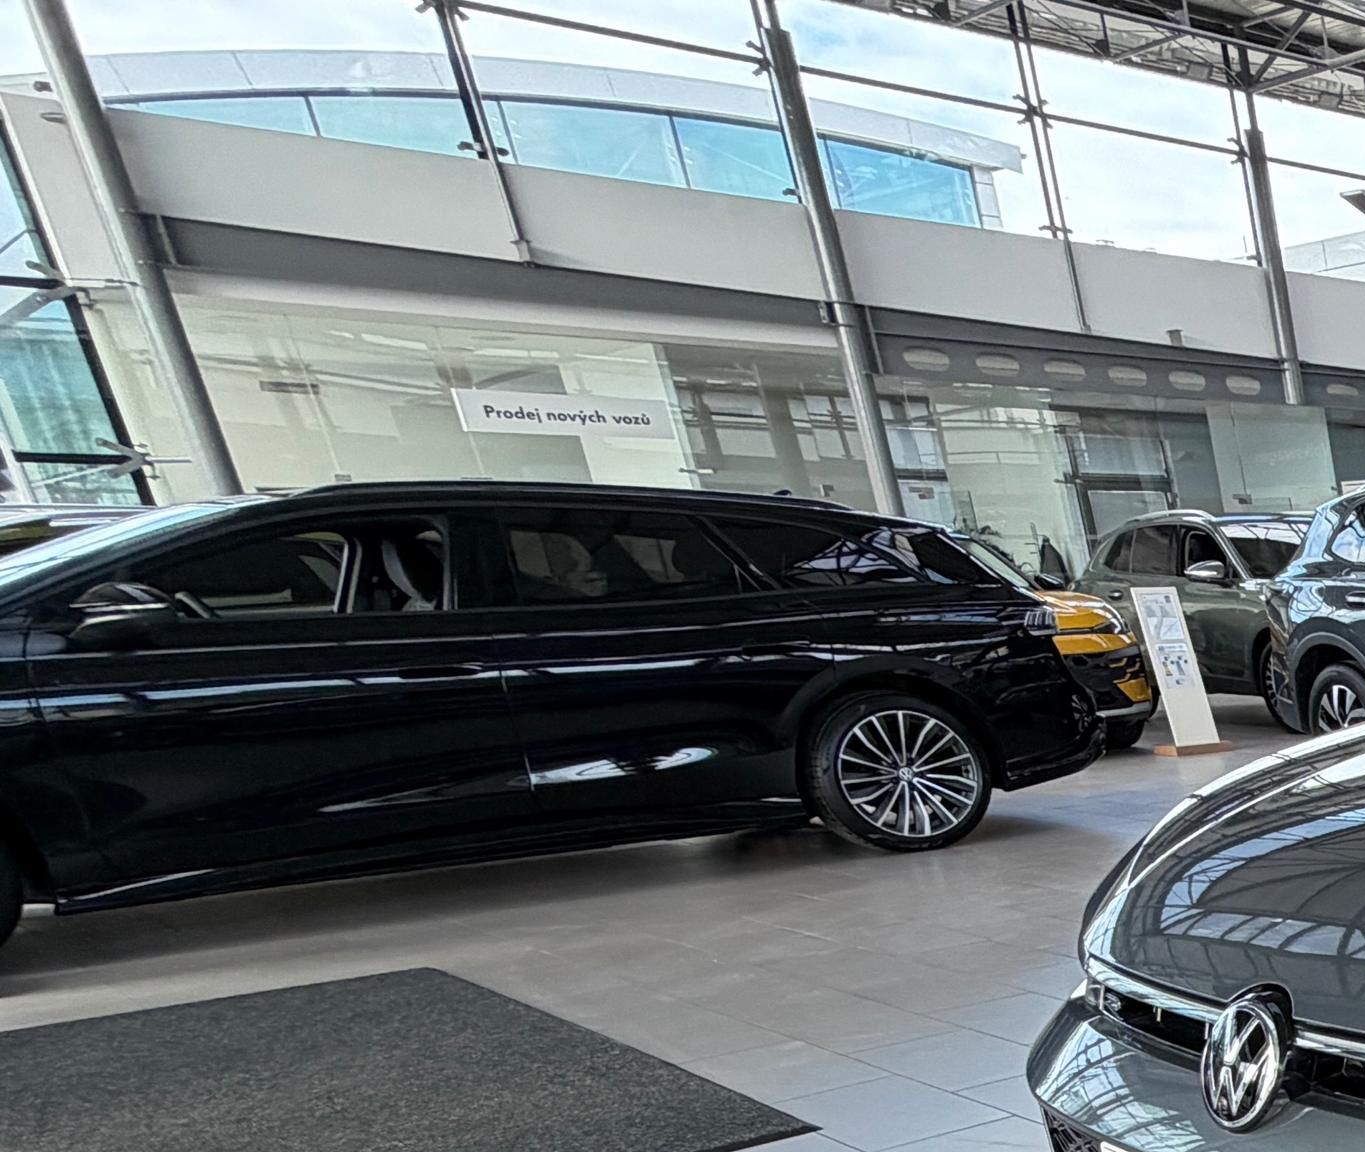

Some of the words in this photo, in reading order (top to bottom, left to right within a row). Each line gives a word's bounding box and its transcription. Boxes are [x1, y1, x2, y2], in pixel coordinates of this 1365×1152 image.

[482, 405, 542, 424] Prodej
[547, 409, 607, 426] nových
[612, 412, 651, 426] vozů
